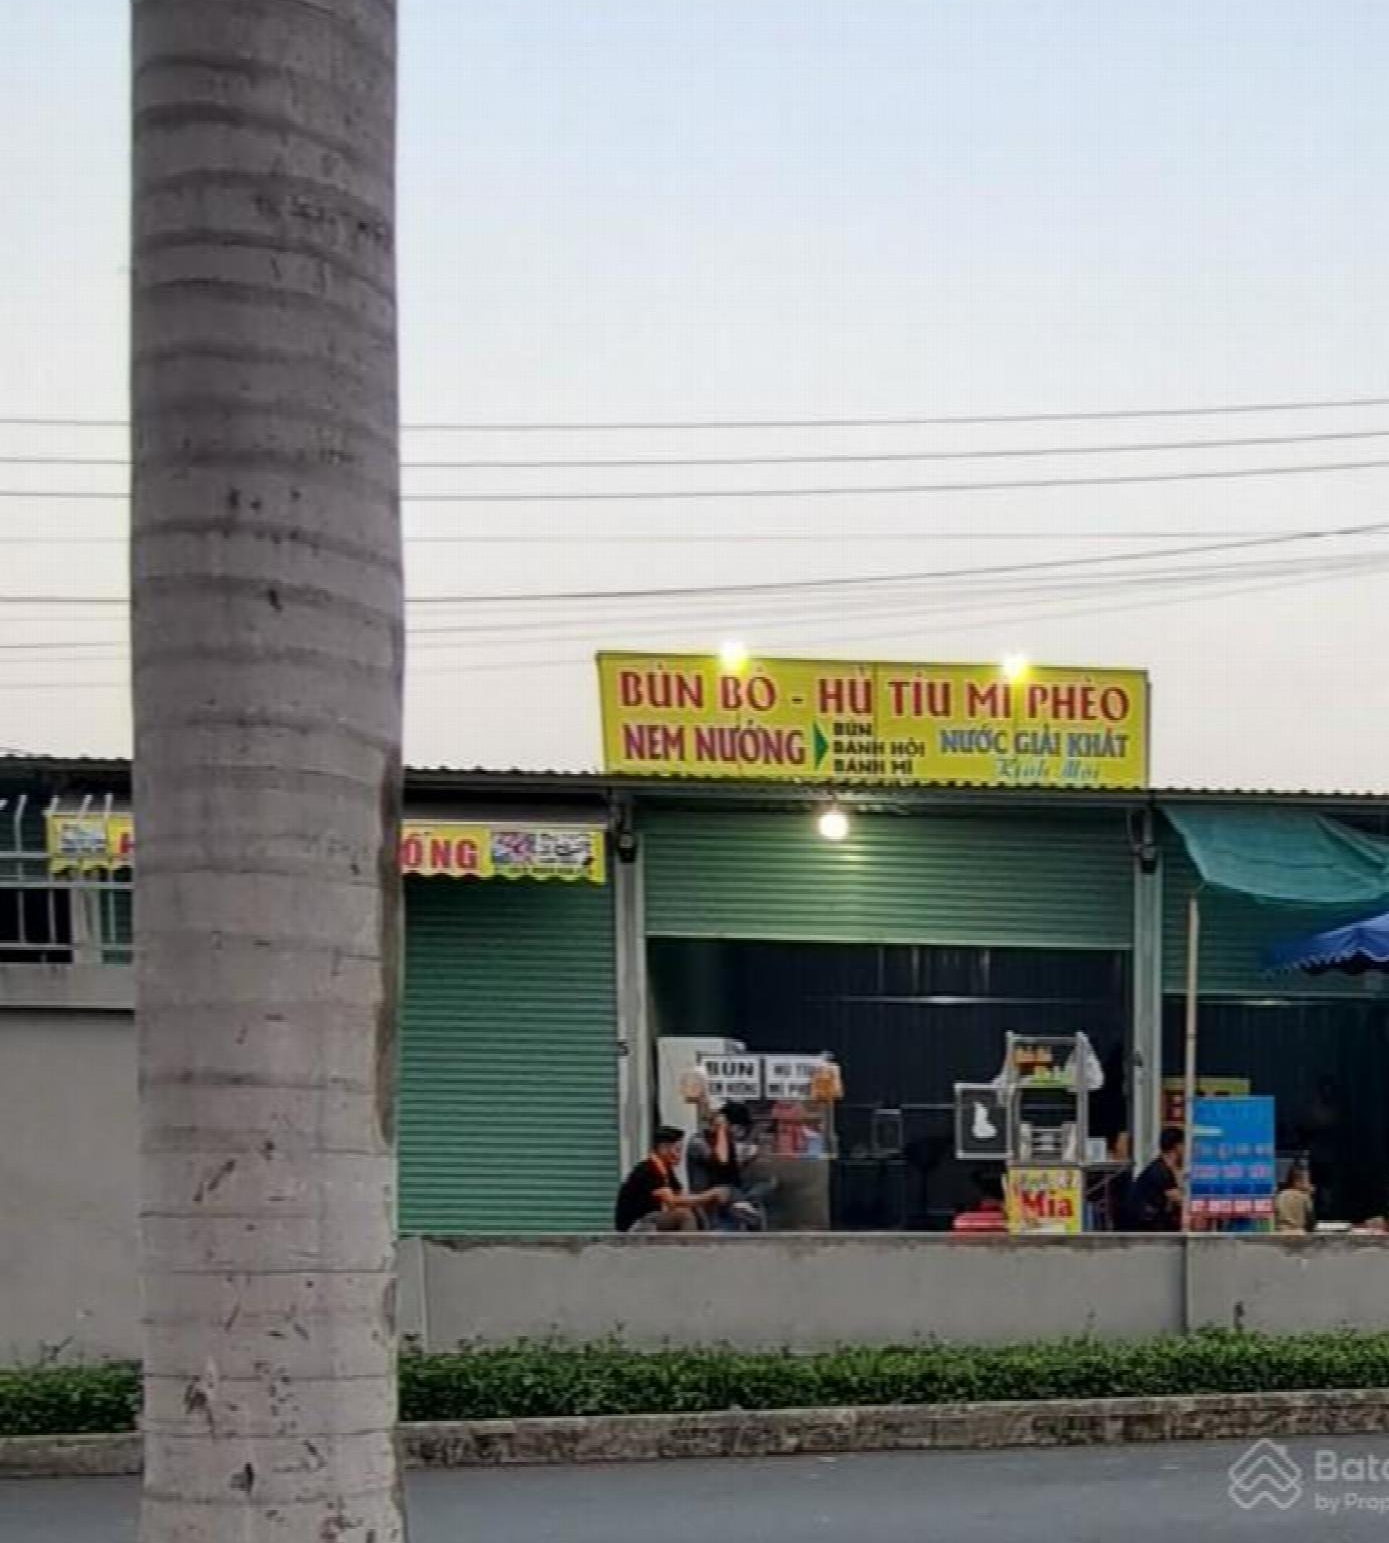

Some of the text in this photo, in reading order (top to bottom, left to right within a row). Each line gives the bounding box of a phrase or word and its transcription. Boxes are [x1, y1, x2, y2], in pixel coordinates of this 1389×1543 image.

[620, 662, 704, 708] BÚN
[720, 666, 777, 712] BÒ
[819, 664, 872, 714] HỦ
[623, 719, 806, 765] NEM NƯỚNG
[940, 722, 1129, 758] NƯỚC GIẢI KHÁT
